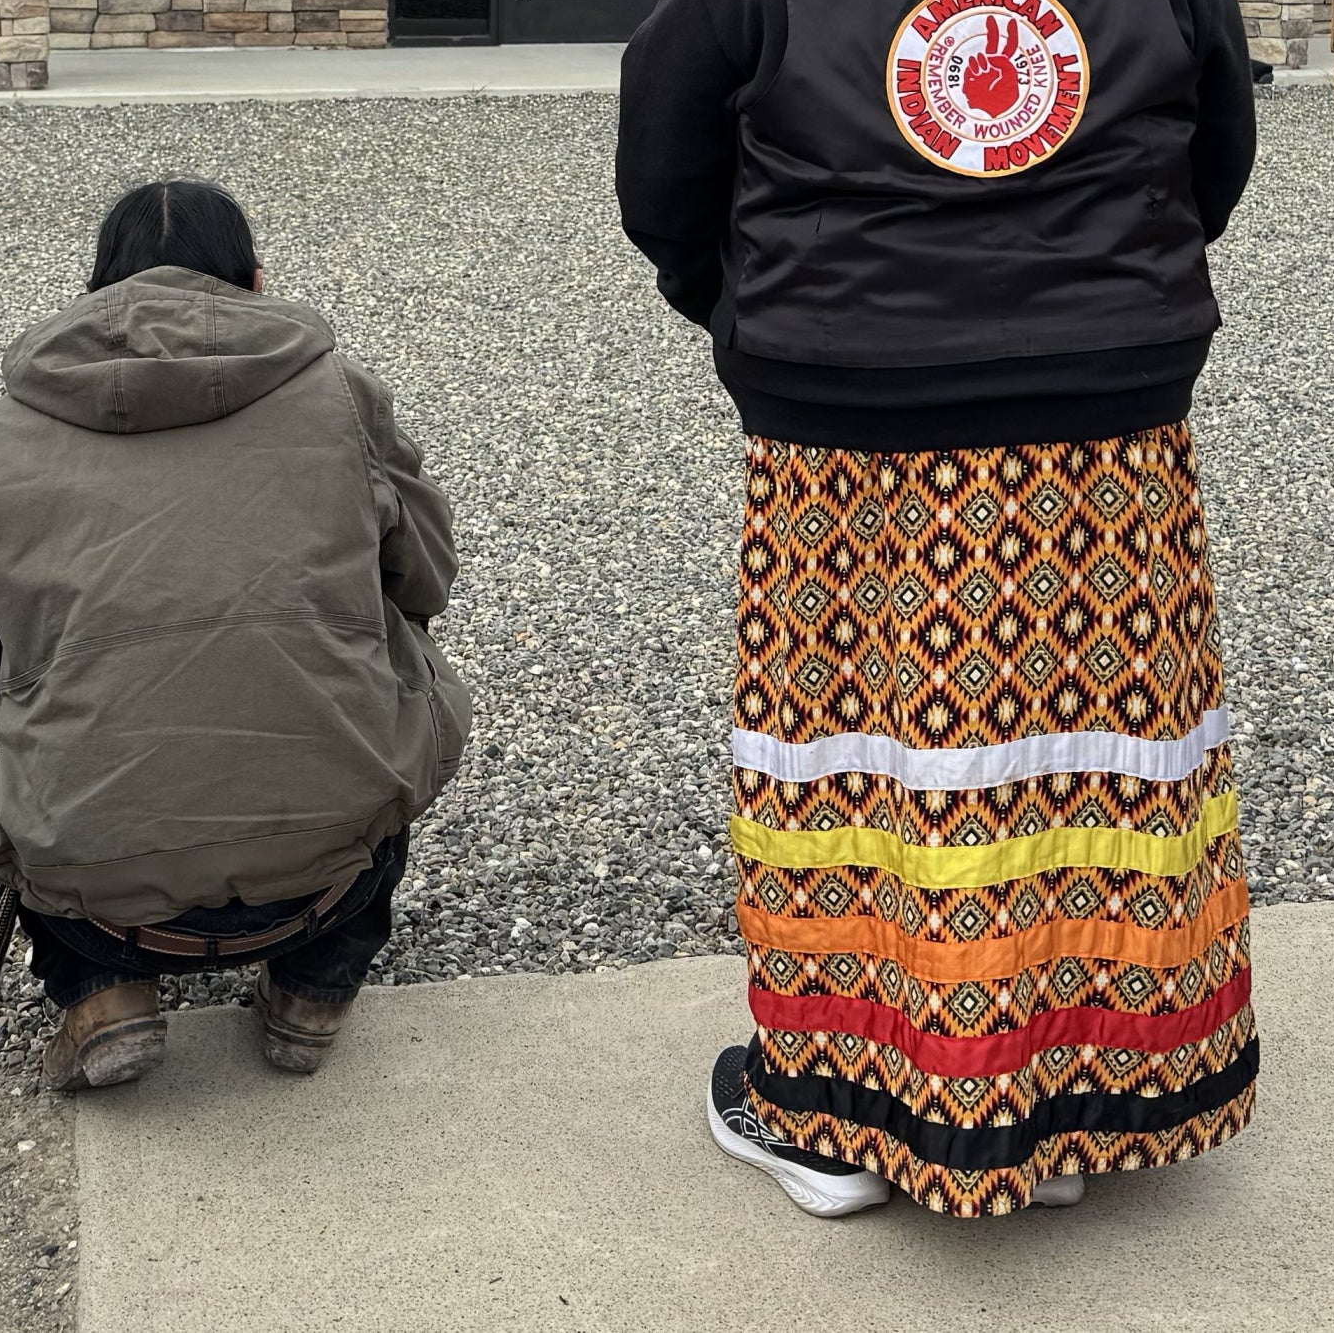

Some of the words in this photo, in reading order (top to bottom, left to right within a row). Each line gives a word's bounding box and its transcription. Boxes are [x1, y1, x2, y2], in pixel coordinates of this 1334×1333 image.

[927, 41, 967, 129] REMEMBER
[974, 94, 1042, 140] WOUNDED
[1026, 44, 1048, 88] KNEE
[948, 55, 964, 89] 1890
[1013, 53, 1028, 86] 1973
[896, 58, 962, 160] INDIAN
[984, 53, 1081, 172] MOVEMENT
